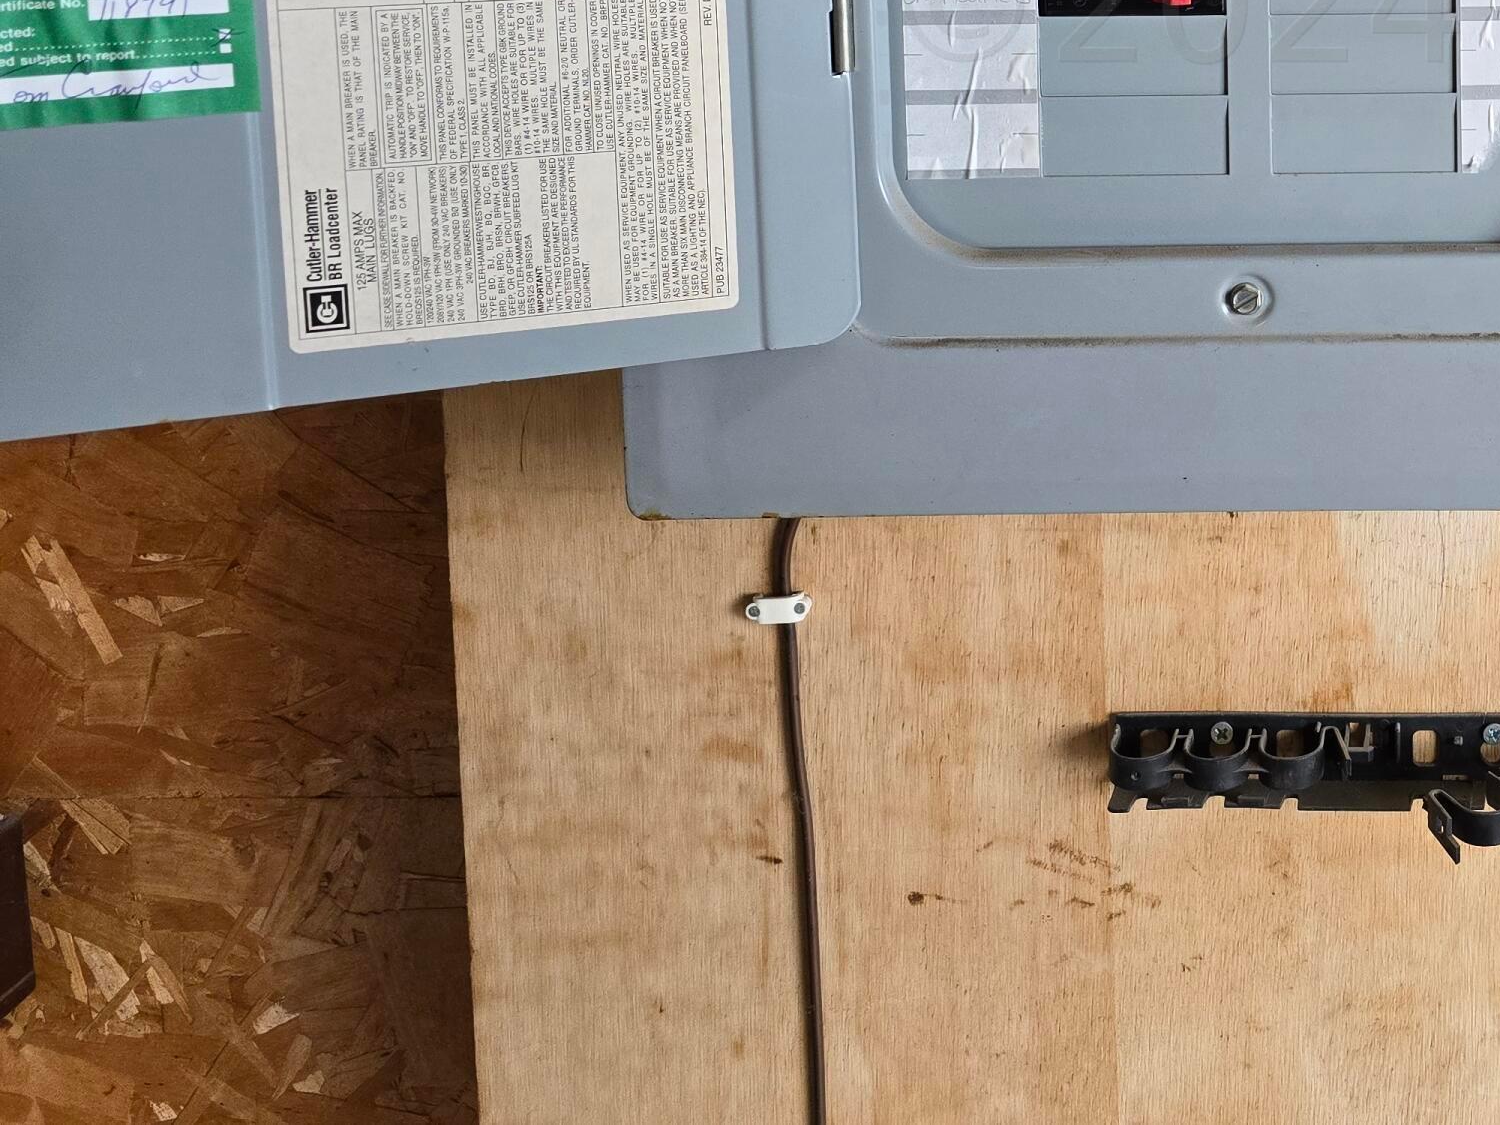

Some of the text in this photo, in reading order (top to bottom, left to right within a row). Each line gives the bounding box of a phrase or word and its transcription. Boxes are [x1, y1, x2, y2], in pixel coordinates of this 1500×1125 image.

[337, 11, 348, 28] THE
[702, 5, 712, 27] REV.
[21, 54, 72, 66] subject
[341, 59, 351, 68] IS
[341, 70, 354, 110] BREAKER
[348, 11, 368, 168] PANEL RATING IS THAT OF THE MAIN
[344, 112, 355, 133] MAIN
[346, 144, 357, 169] WHEN
[299, 189, 323, 283] Cutler-Hammer
[321, 187, 343, 281] BR Loadcenter
[350, 211, 368, 291] 125 AMPS MAX
[362, 218, 377, 284] MAIN LUGS
[534, 265, 545, 314] IMPORTANT:
[714, 246, 725, 295] PUB 23477
